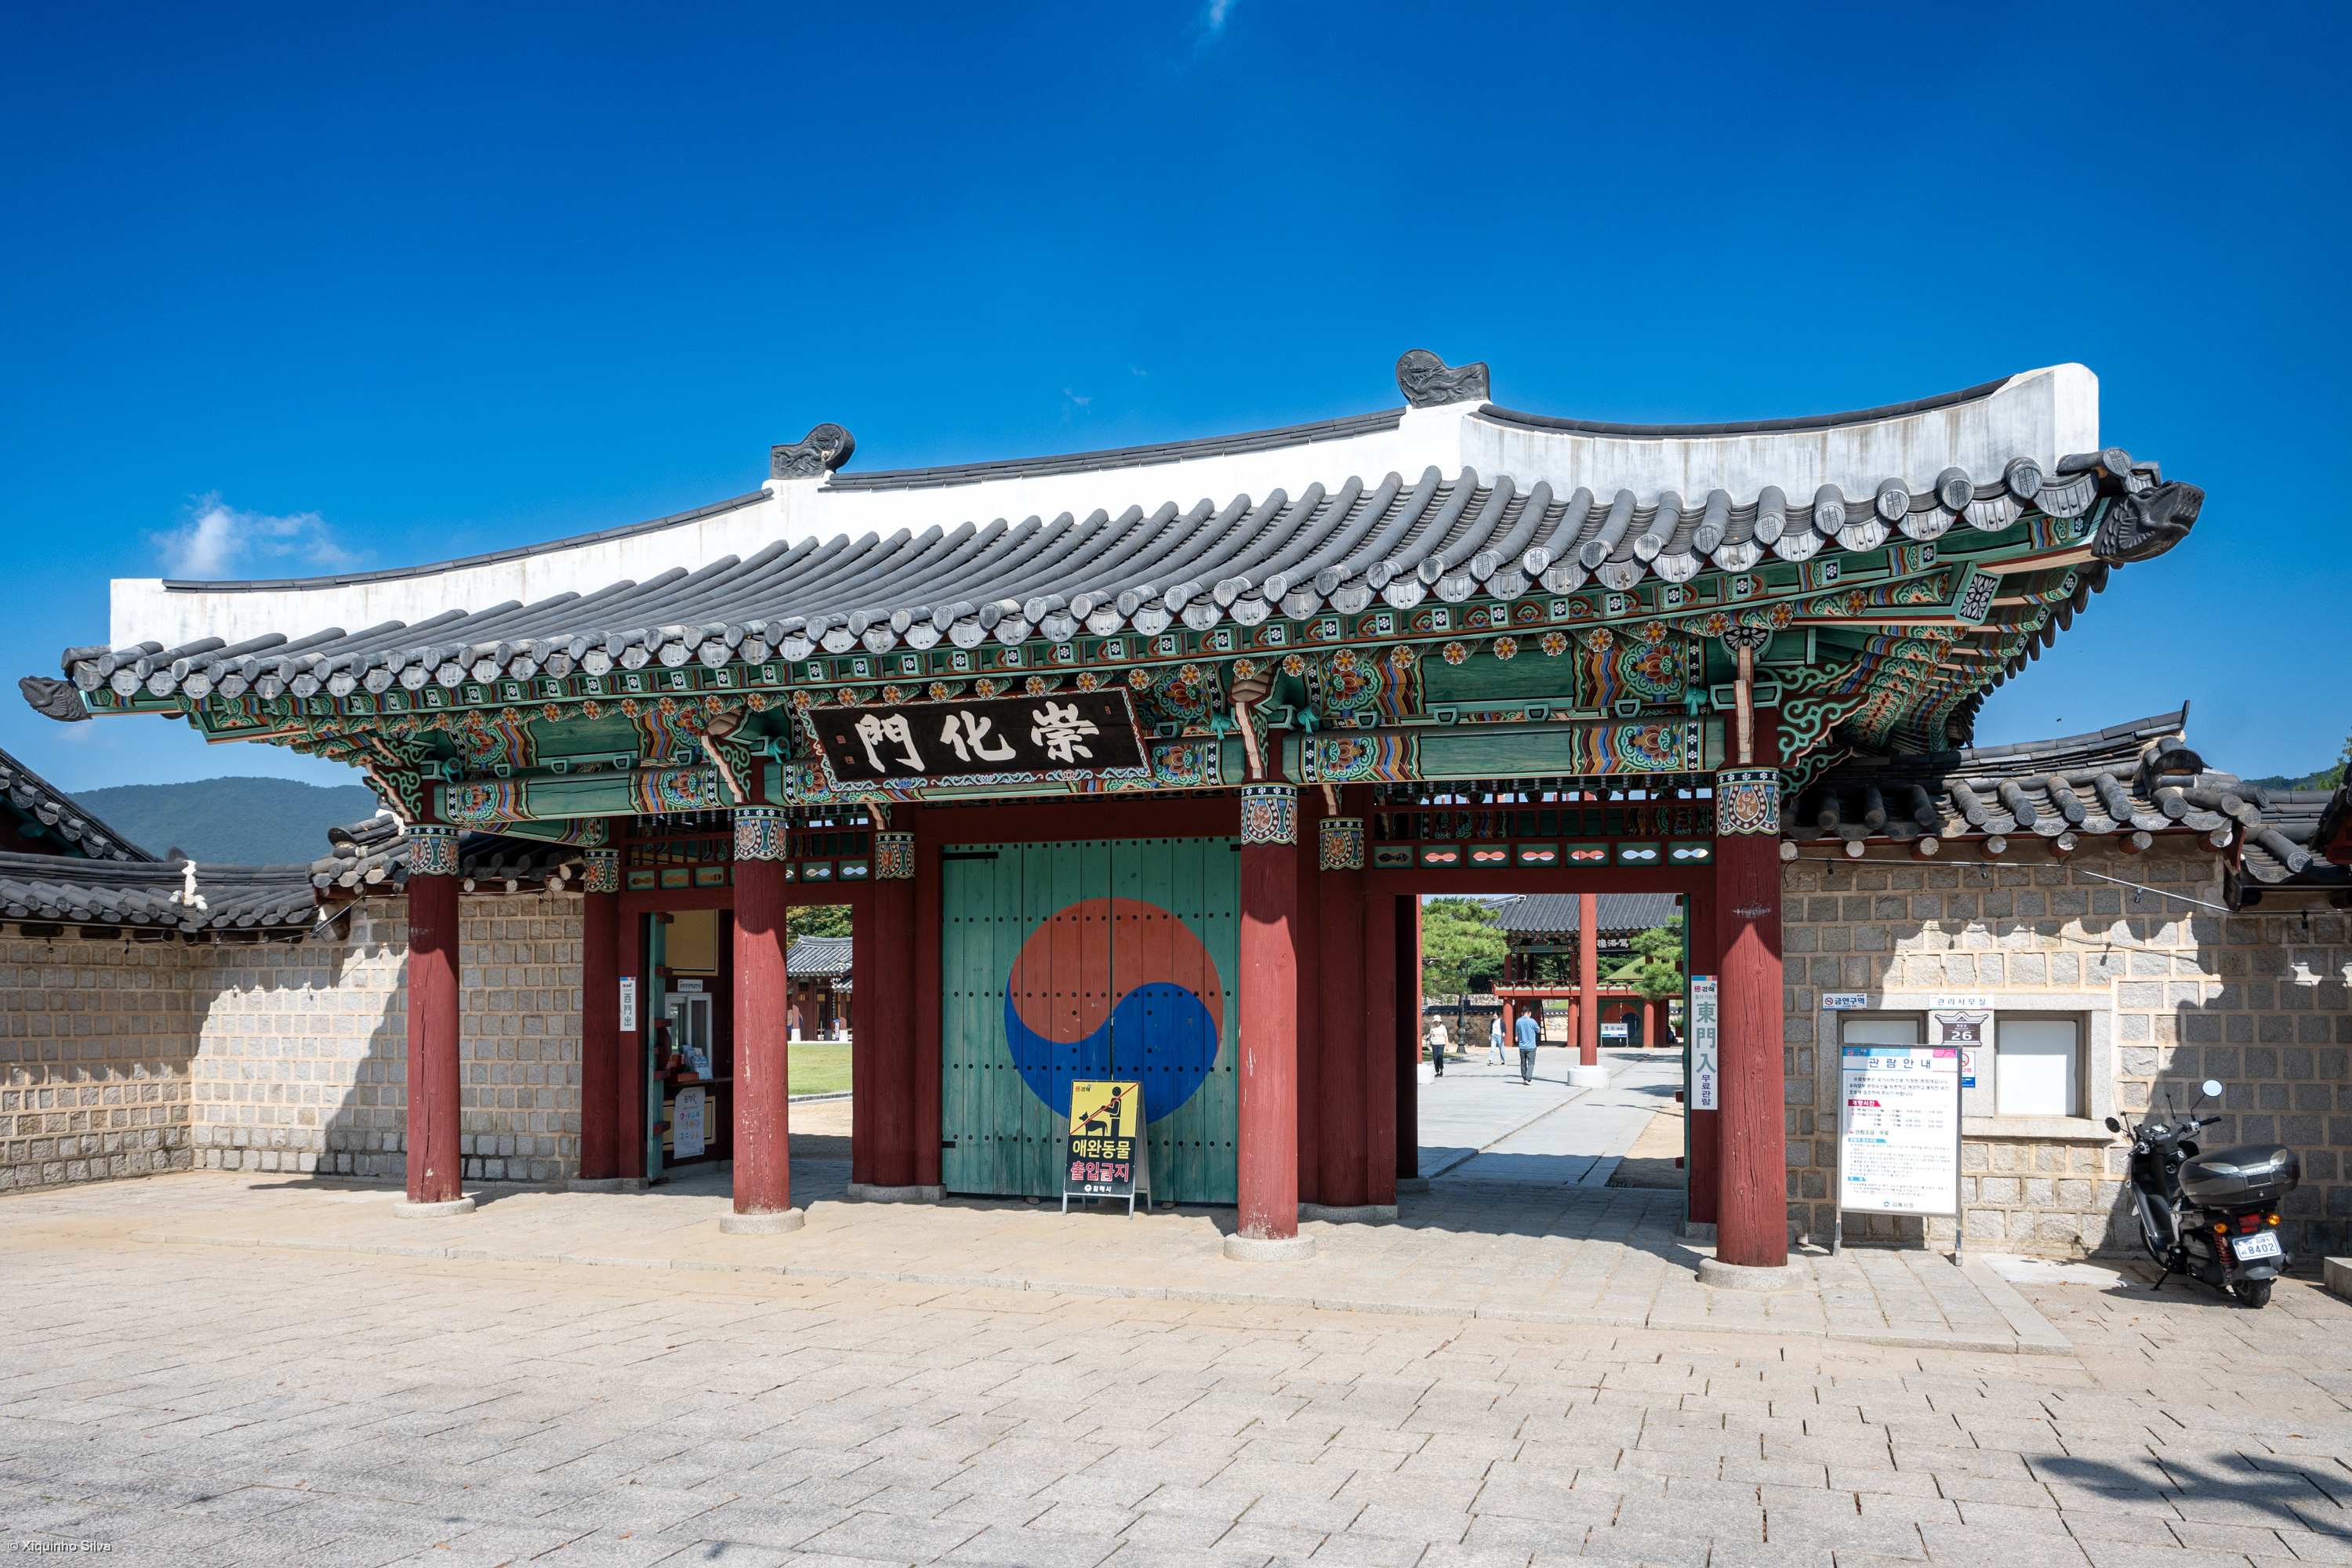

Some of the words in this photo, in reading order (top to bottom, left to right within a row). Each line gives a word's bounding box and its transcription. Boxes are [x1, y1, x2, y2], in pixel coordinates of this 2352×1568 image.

[1951, 1031, 1973, 1040] 26
[1072, 1139, 1131, 1160] 애완동물
[1070, 1160, 1130, 1182] 출입금지
[2248, 1243, 2275, 1254] 8402
